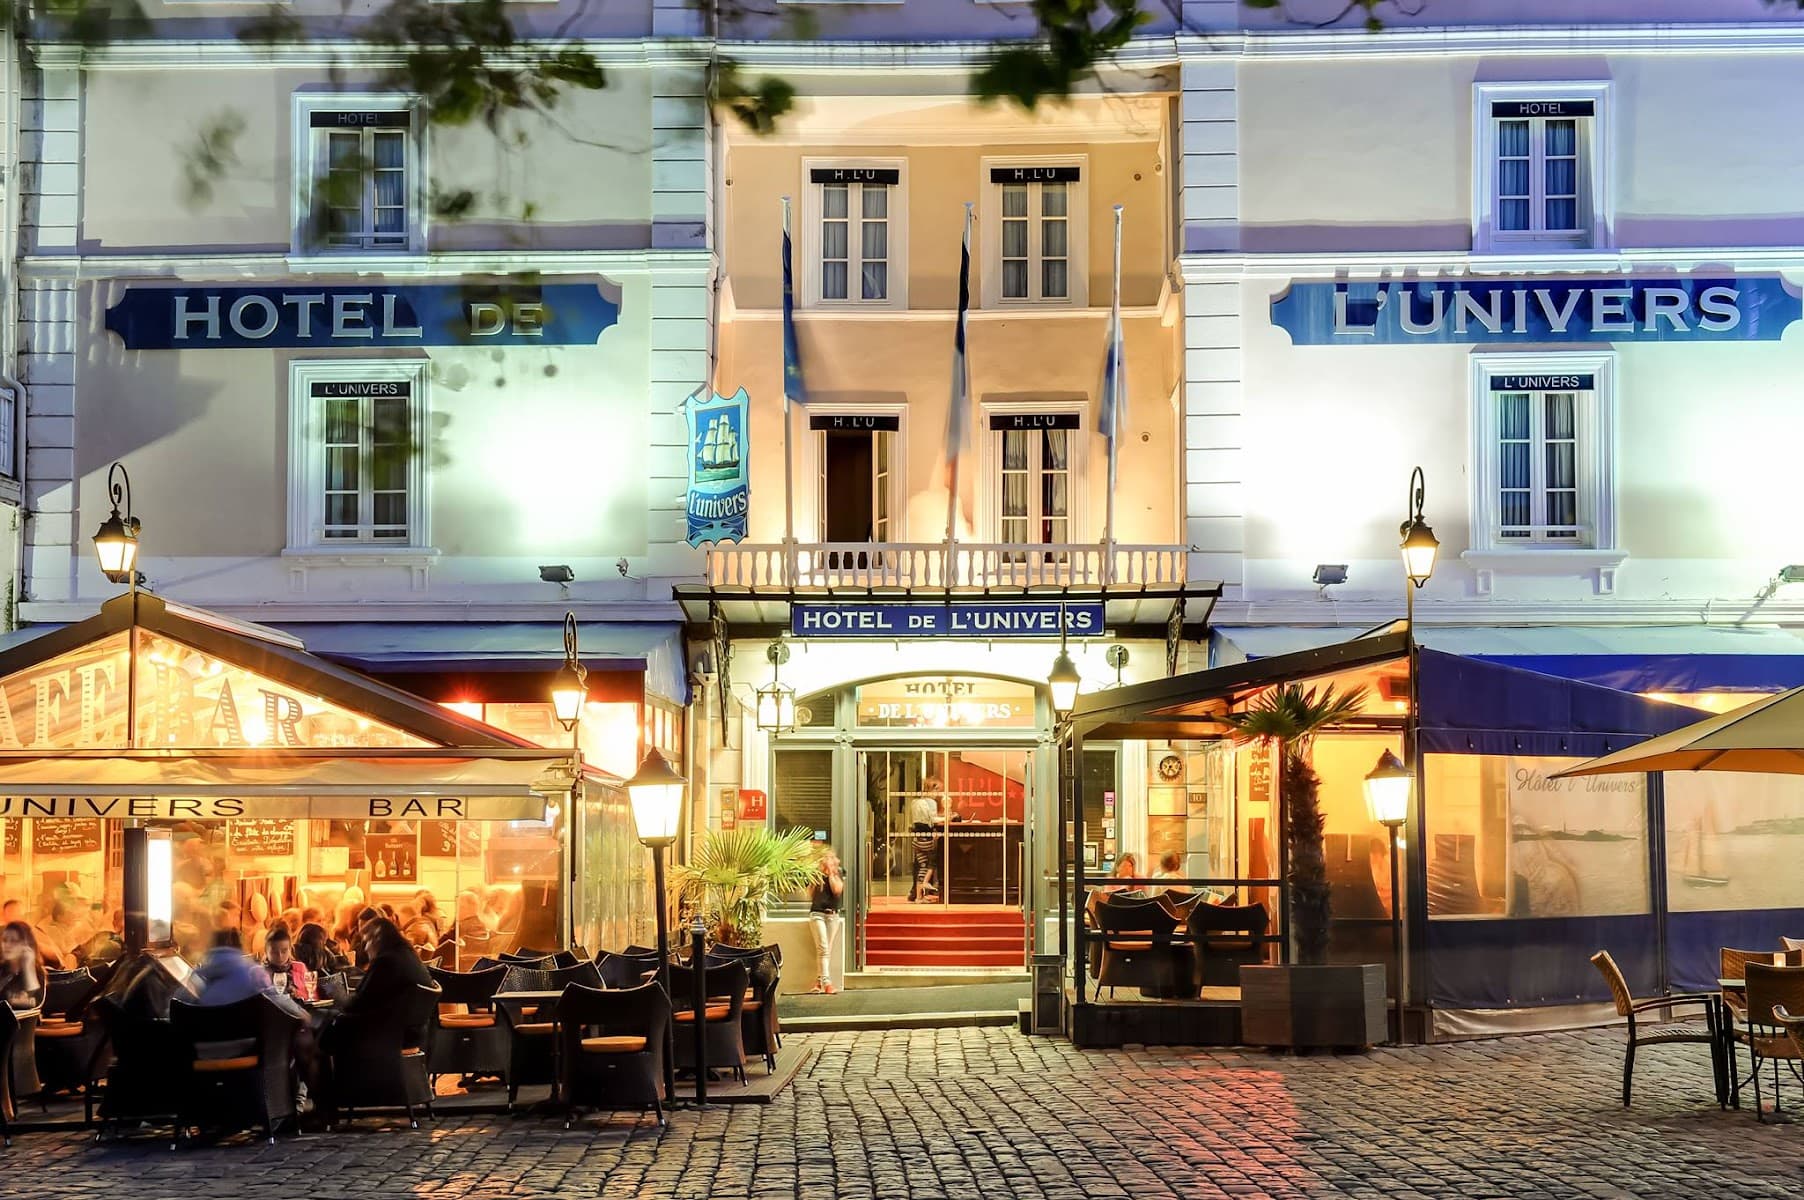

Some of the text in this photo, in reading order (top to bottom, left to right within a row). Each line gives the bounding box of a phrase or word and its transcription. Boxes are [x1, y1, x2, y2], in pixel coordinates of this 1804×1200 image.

[337, 112, 384, 125] HOTEL
[1519, 103, 1567, 115] HOTEL
[173, 293, 544, 339] HOTEL DE
[1333, 287, 1741, 336] L'UNIVERS
[689, 491, 747, 519] l'univers
[803, 610, 1093, 630] HOTEL DE L'UNIVERS
[905, 682, 976, 697] HOTEL
[149, 660, 306, 746] BAR
[368, 798, 464, 817] BAR
[751, 795, 763, 807] H
